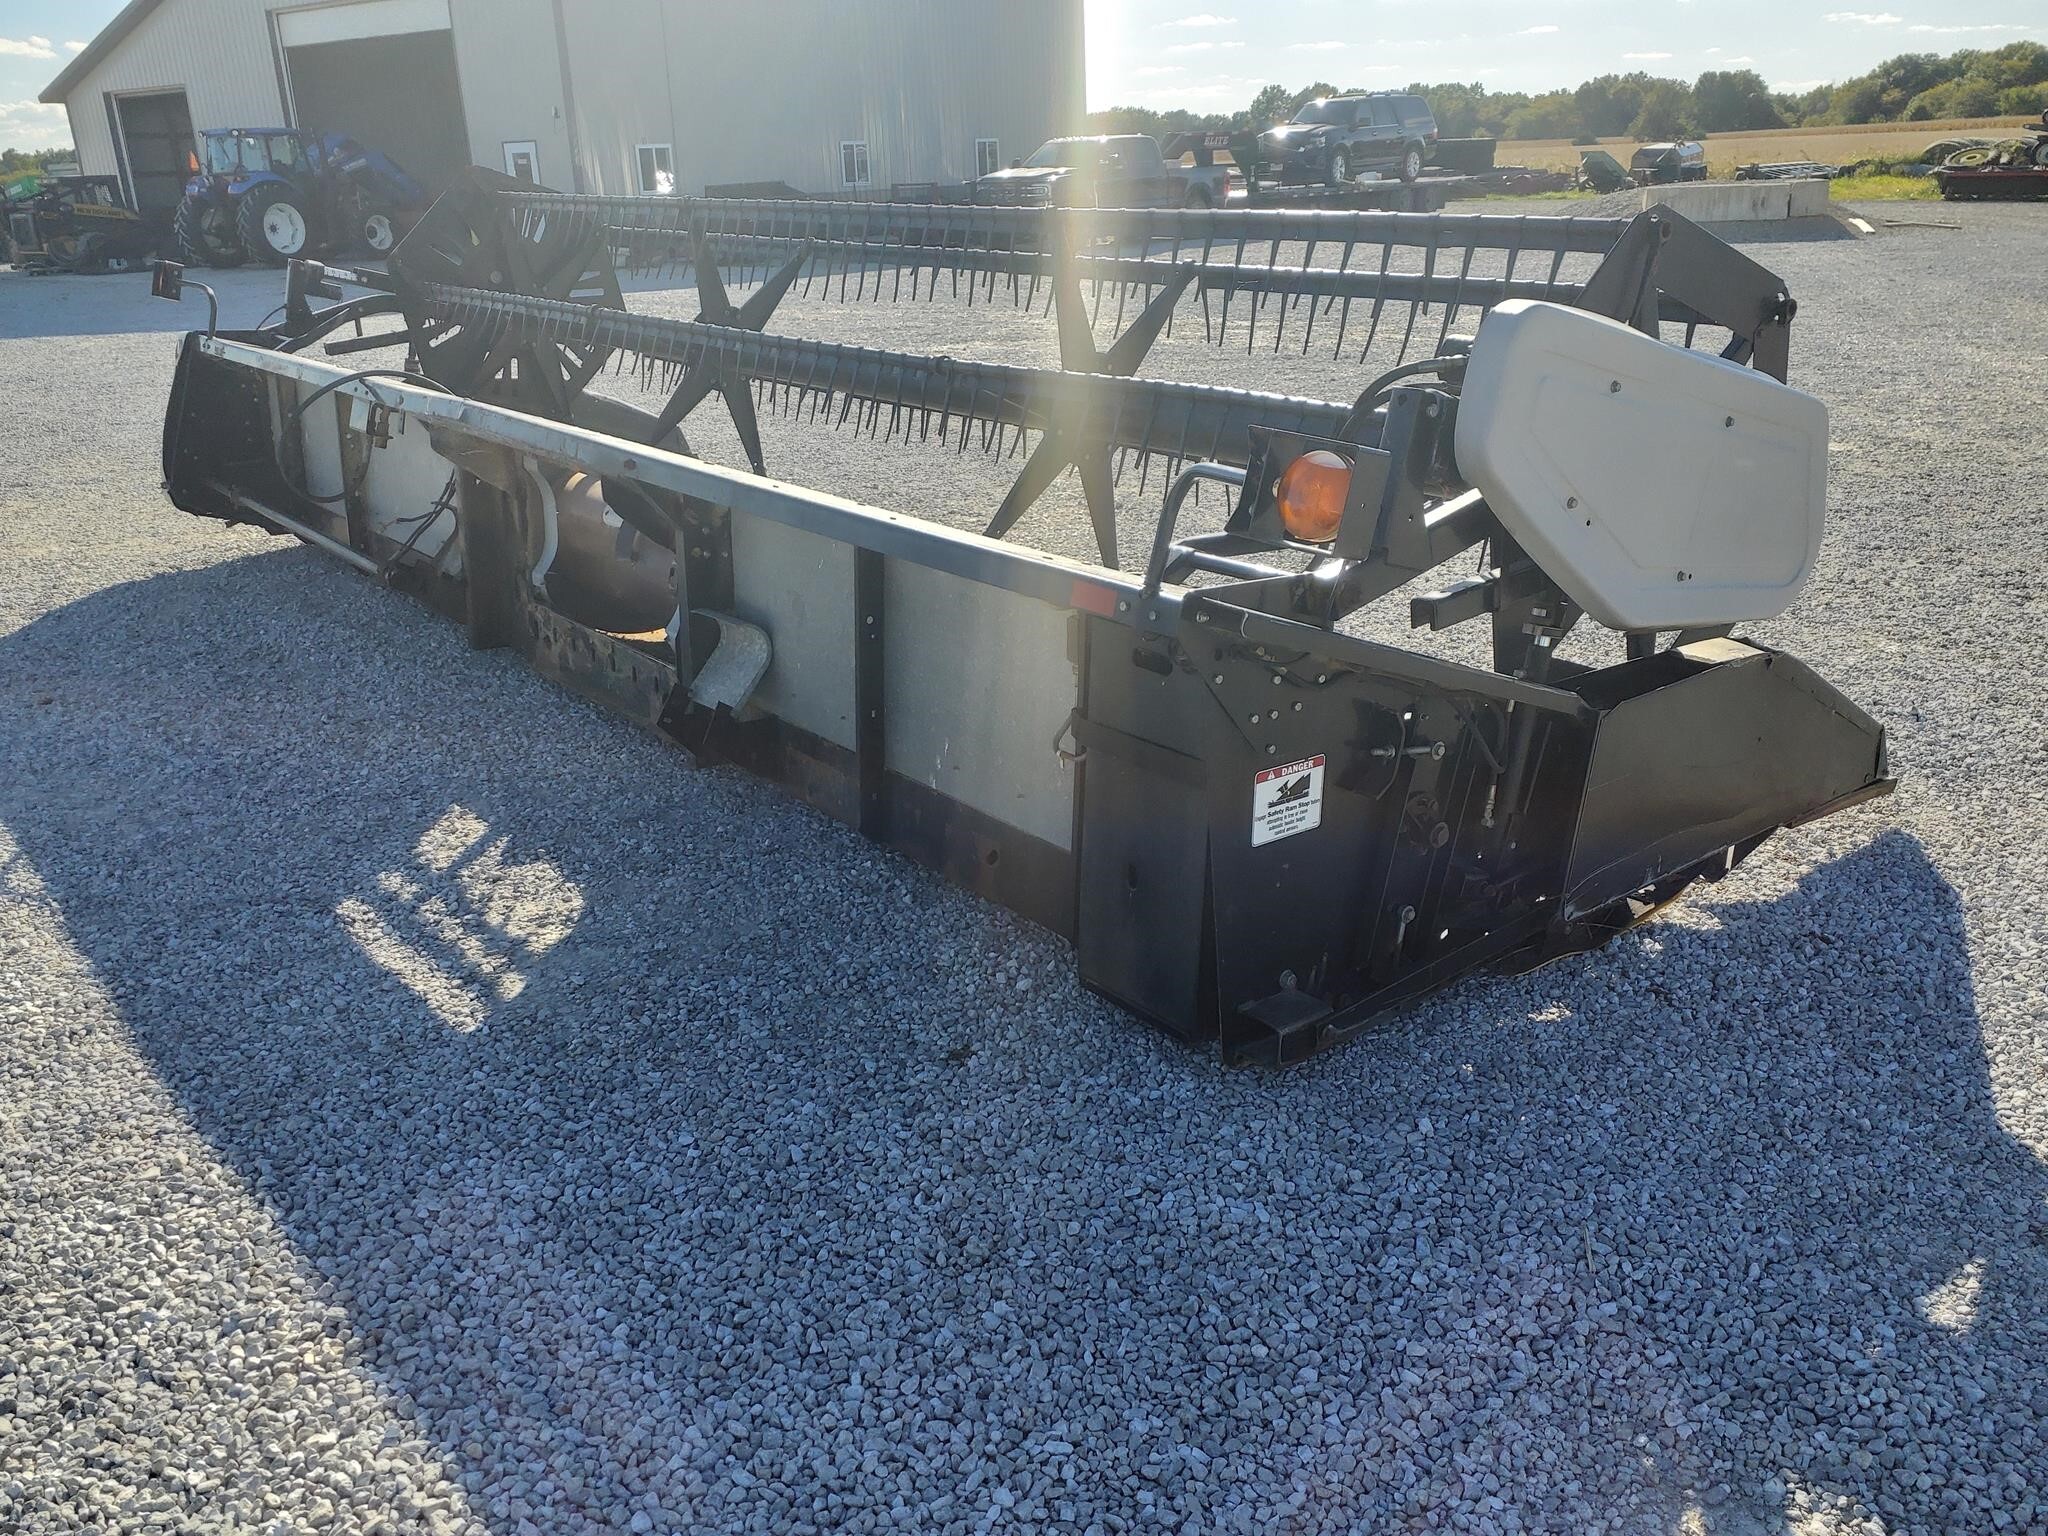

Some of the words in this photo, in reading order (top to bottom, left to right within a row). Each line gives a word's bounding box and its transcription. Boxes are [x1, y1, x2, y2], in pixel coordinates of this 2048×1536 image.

[1203, 135, 1229, 145] ELITE
[1281, 760, 1314, 776] DANGER
[1268, 809, 1284, 818] Safety
[1298, 801, 1310, 809] Stop
